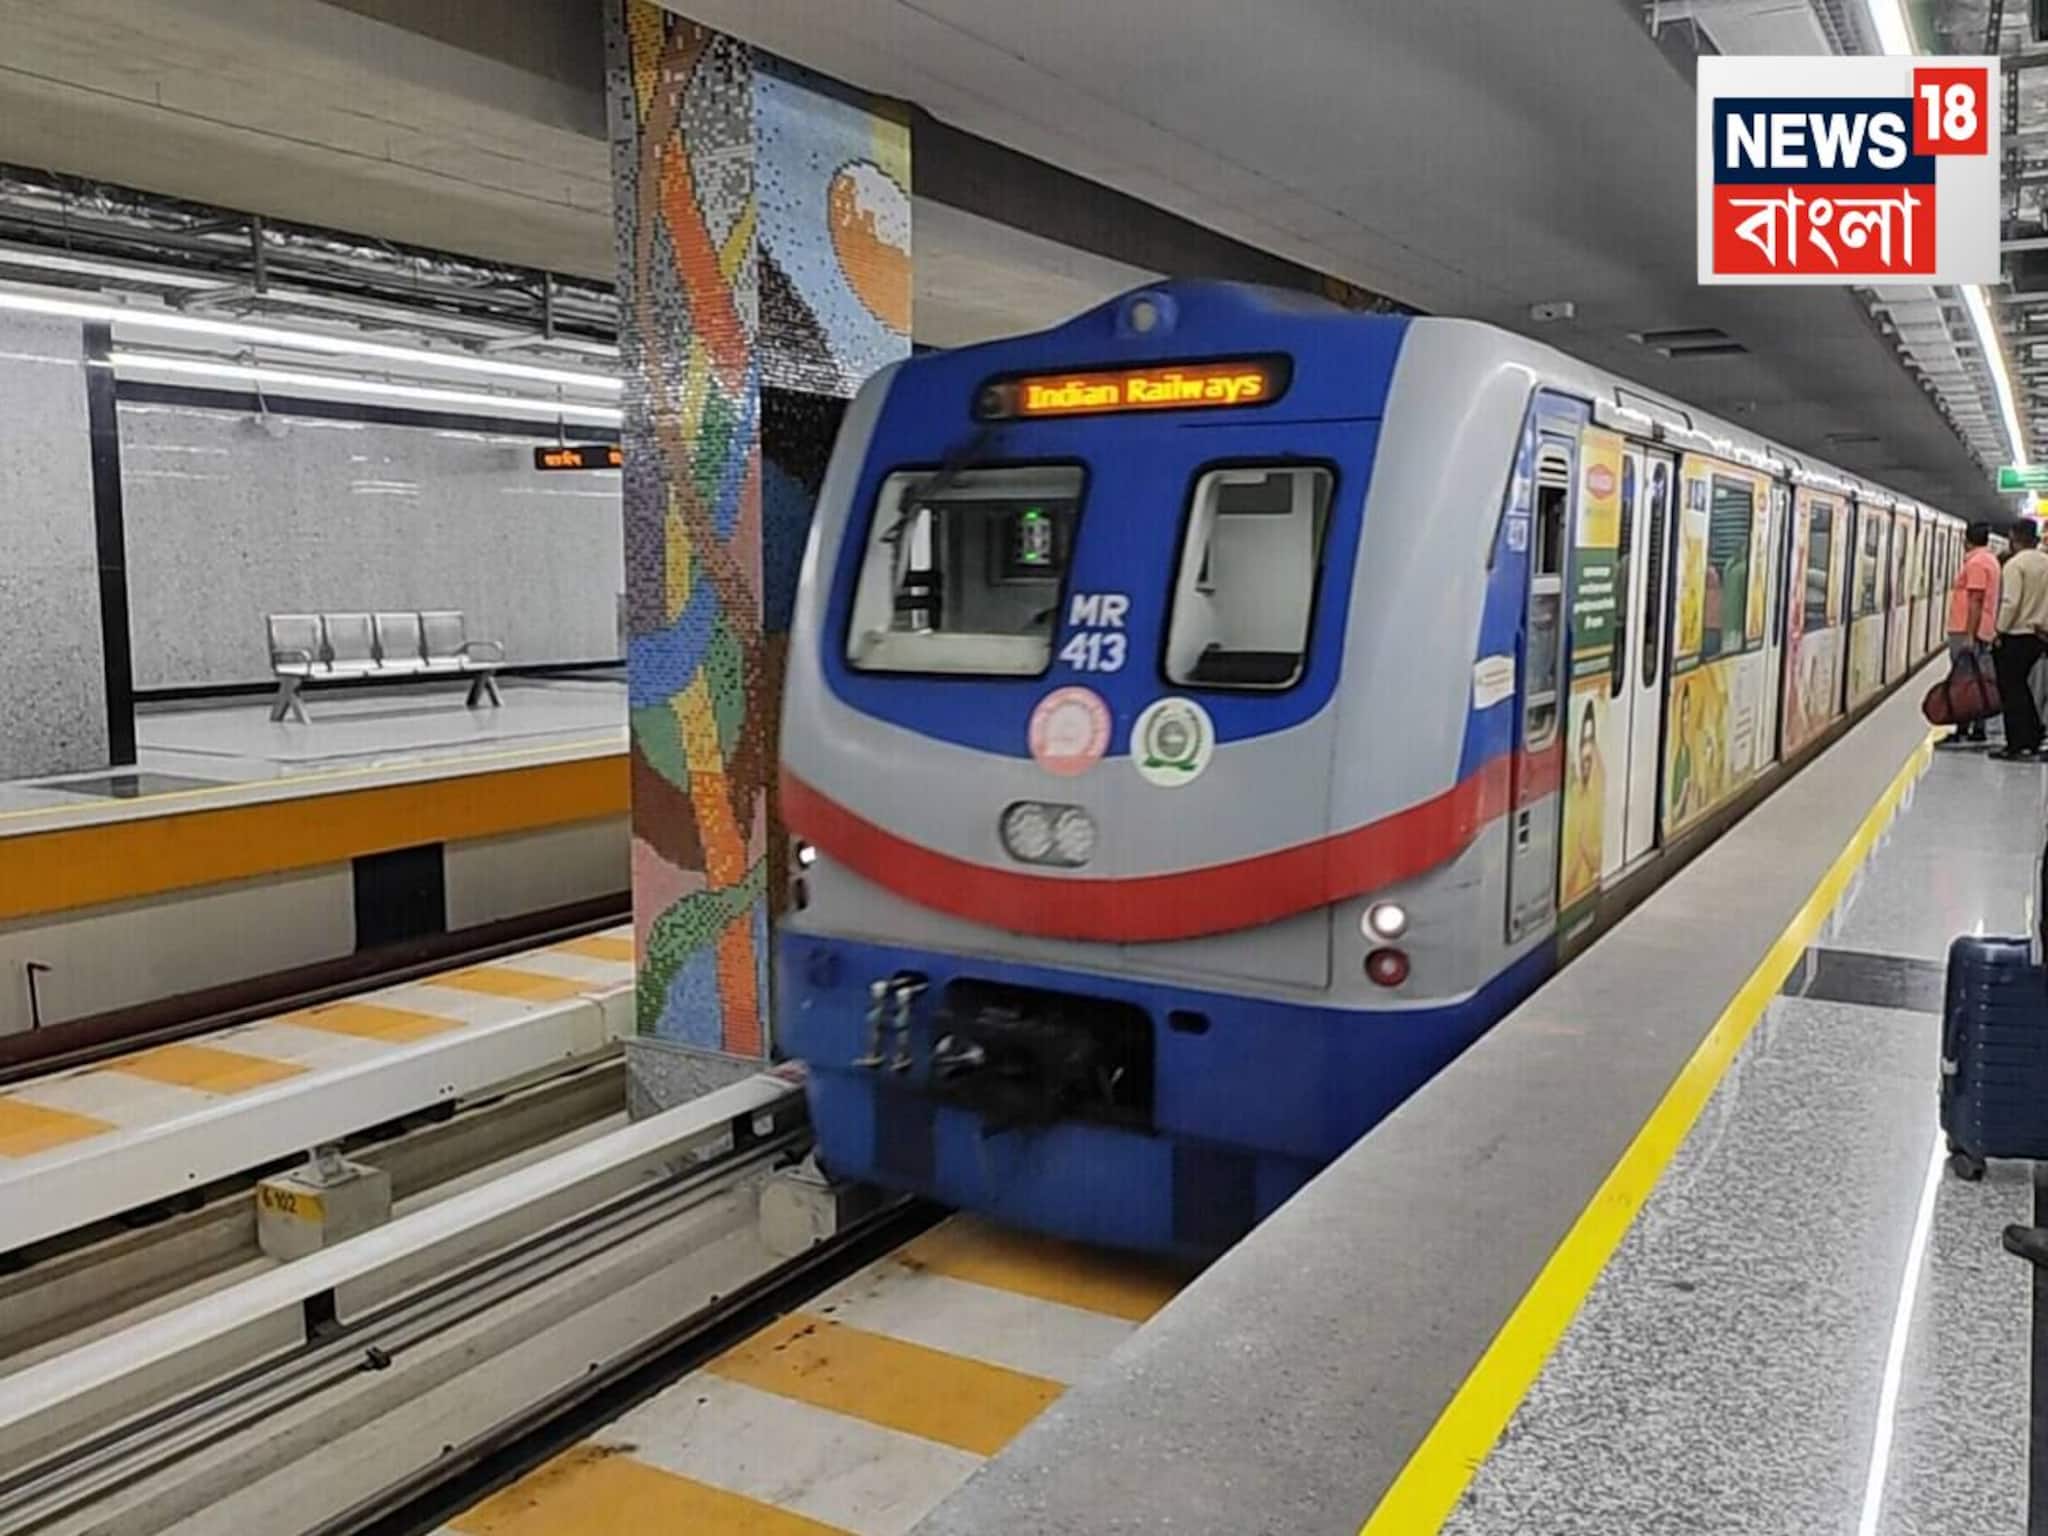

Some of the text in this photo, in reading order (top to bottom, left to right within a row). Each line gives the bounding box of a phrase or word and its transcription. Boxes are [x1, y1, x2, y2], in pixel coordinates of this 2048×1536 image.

[1026, 373, 1263, 409] Indian Railways
[1069, 594, 1130, 627] MR
[1058, 632, 1127, 672] 413
